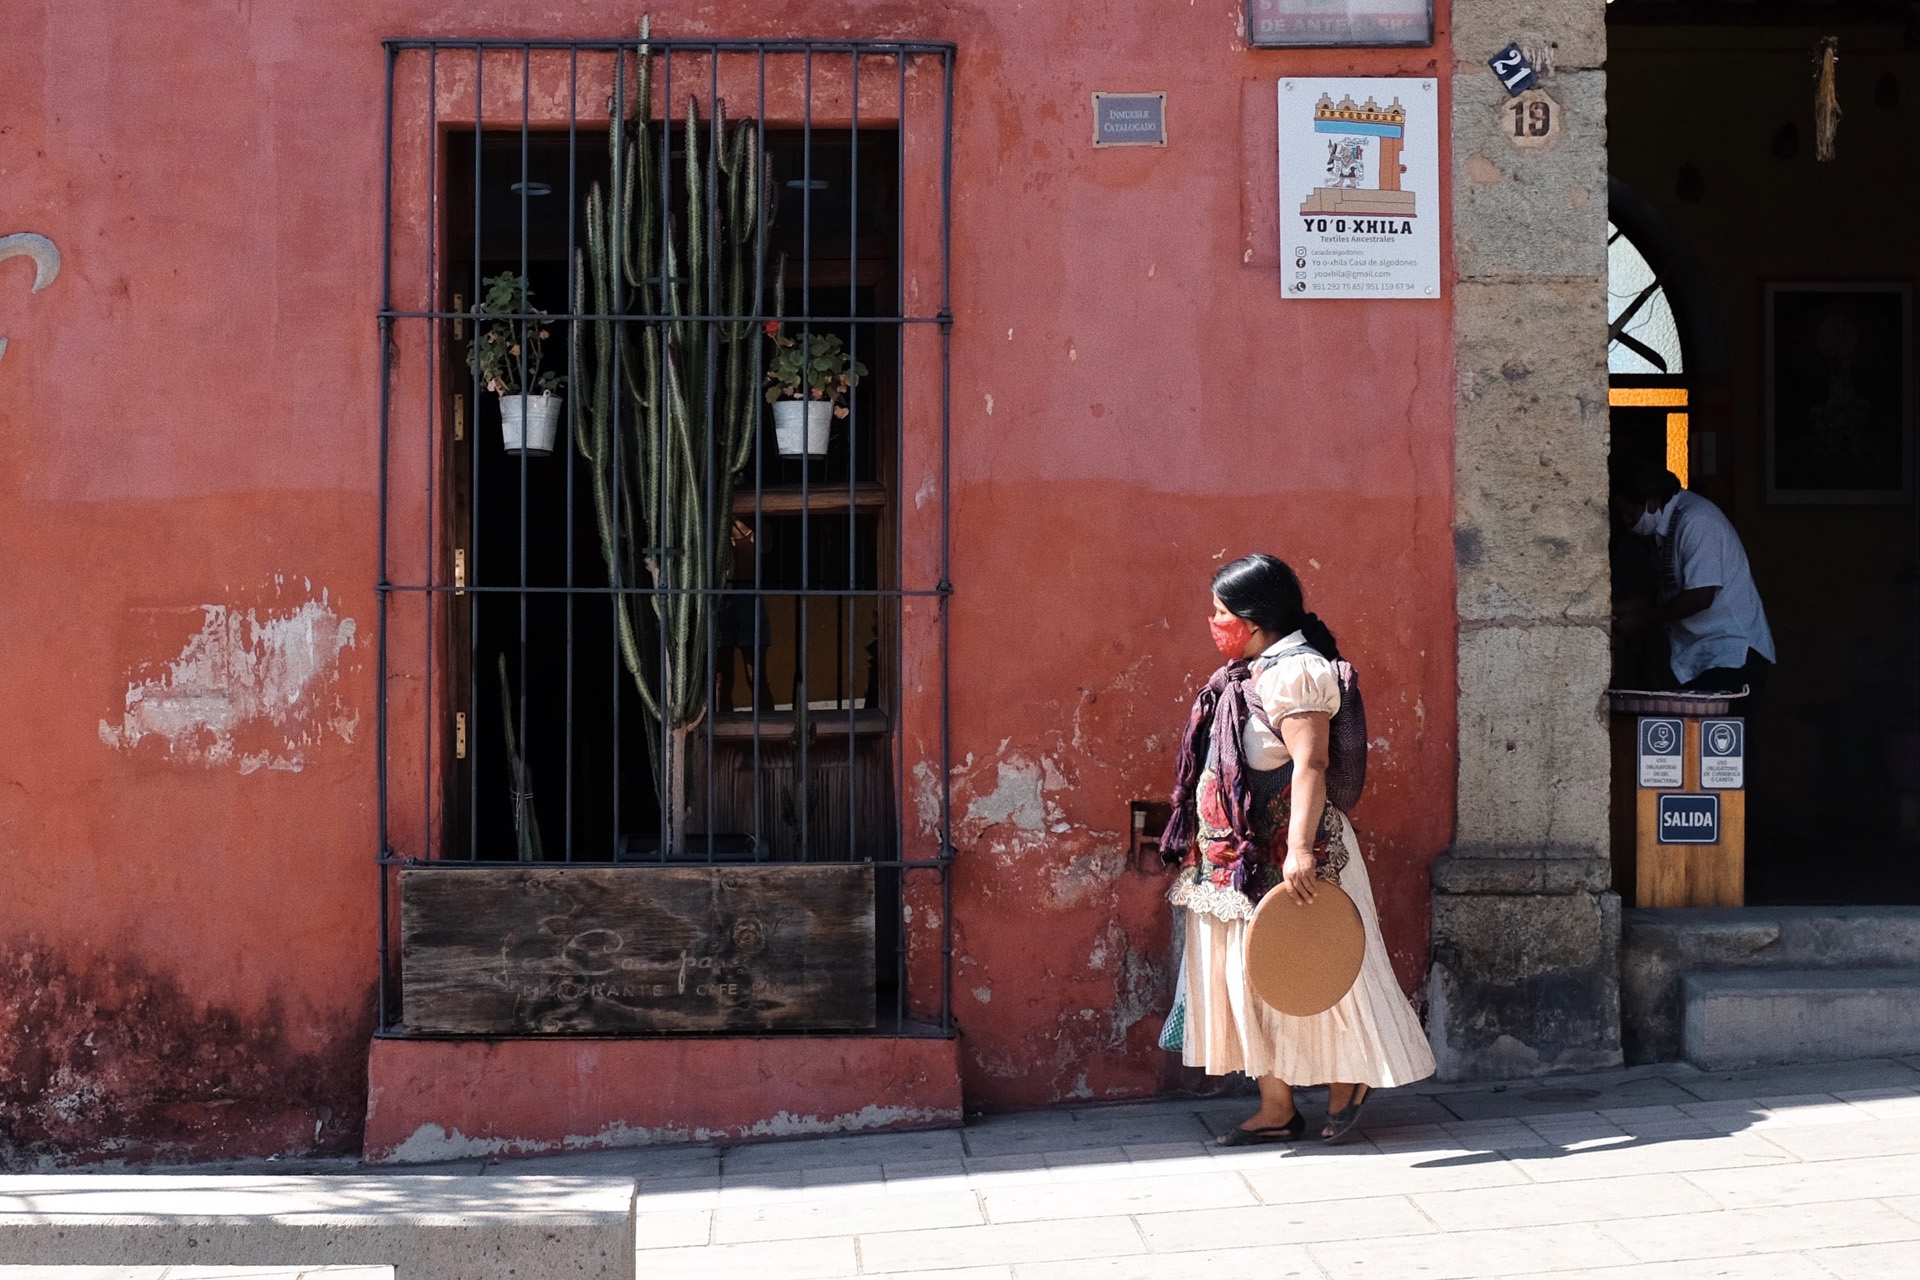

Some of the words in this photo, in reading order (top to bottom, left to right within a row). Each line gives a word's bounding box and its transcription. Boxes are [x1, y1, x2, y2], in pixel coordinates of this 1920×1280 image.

[1493, 49, 1532, 90] 21
[1109, 110, 1150, 120] INMUEBLE
[1509, 101, 1551, 137] 19
[1104, 122, 1156, 132] CATALOGADO
[1320, 235, 1350, 243] Textiles
[1351, 235, 1395, 243] Ancestrales
[1368, 258, 1378, 266] de
[1379, 258, 1417, 268] algodones
[1312, 283, 1325, 291] 951
[1365, 283, 1379, 291] 951
[1663, 811, 1713, 827] SALIDA
